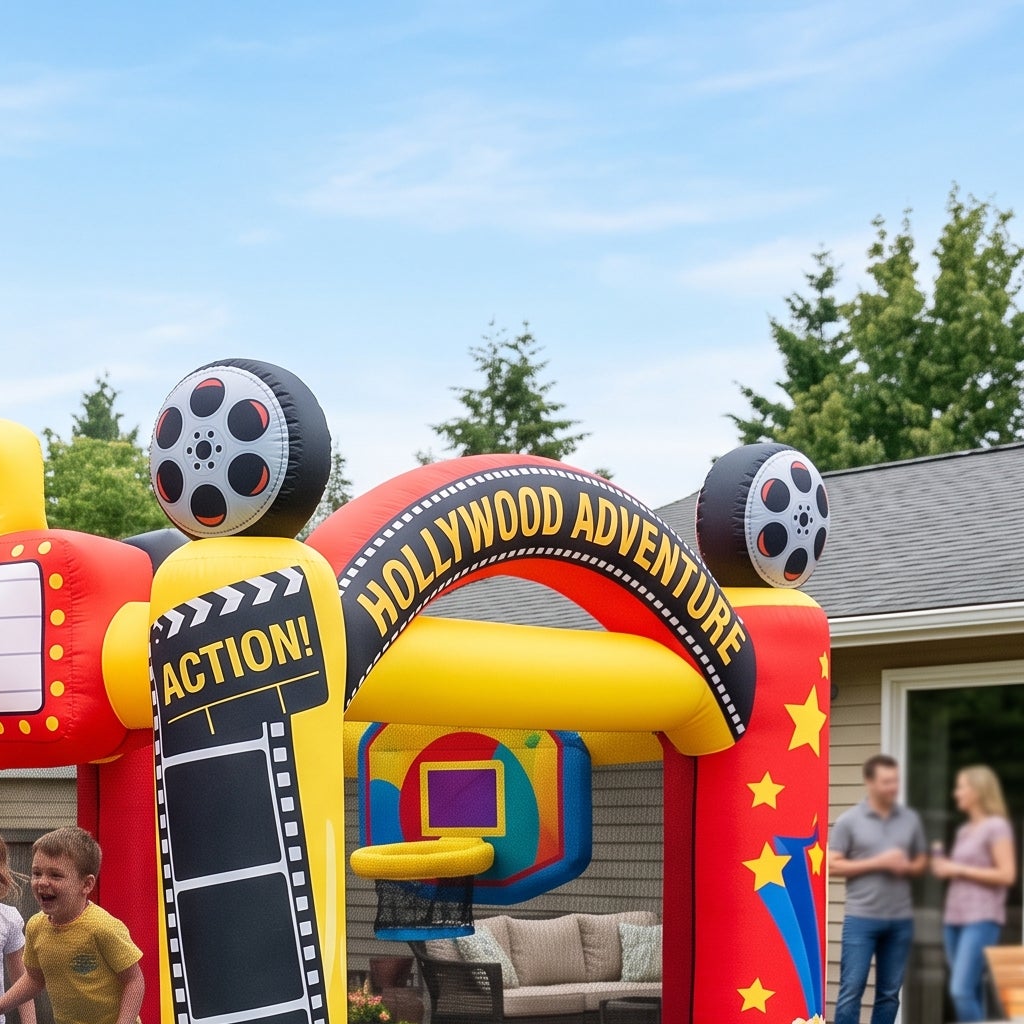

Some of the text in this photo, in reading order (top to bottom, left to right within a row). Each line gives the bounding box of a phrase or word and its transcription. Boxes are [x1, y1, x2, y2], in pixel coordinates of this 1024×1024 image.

[357, 485, 748, 667] HOLLYWOOD ADVENTURE
[161, 615, 314, 706] ACTION!
